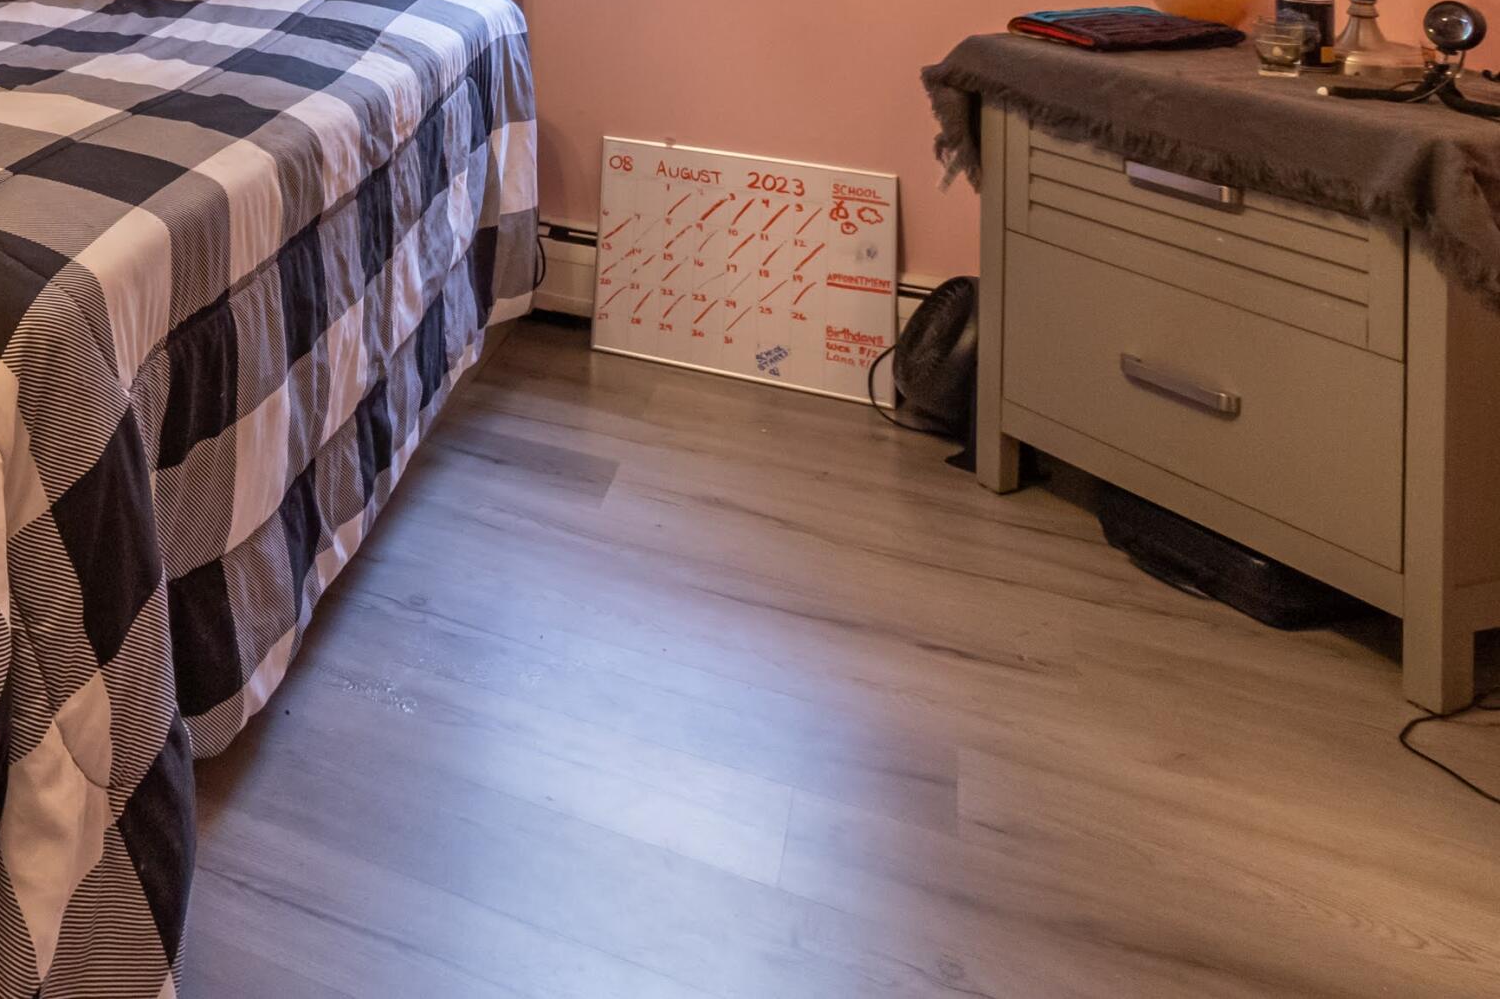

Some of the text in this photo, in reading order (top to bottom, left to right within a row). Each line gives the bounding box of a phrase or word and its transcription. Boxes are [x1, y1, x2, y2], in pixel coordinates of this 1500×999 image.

[609, 155, 805, 197] 08 AUGUST 2023
[832, 183, 882, 199] SCHOOL
[760, 232, 769, 241] 11
[726, 264, 737, 272] 17
